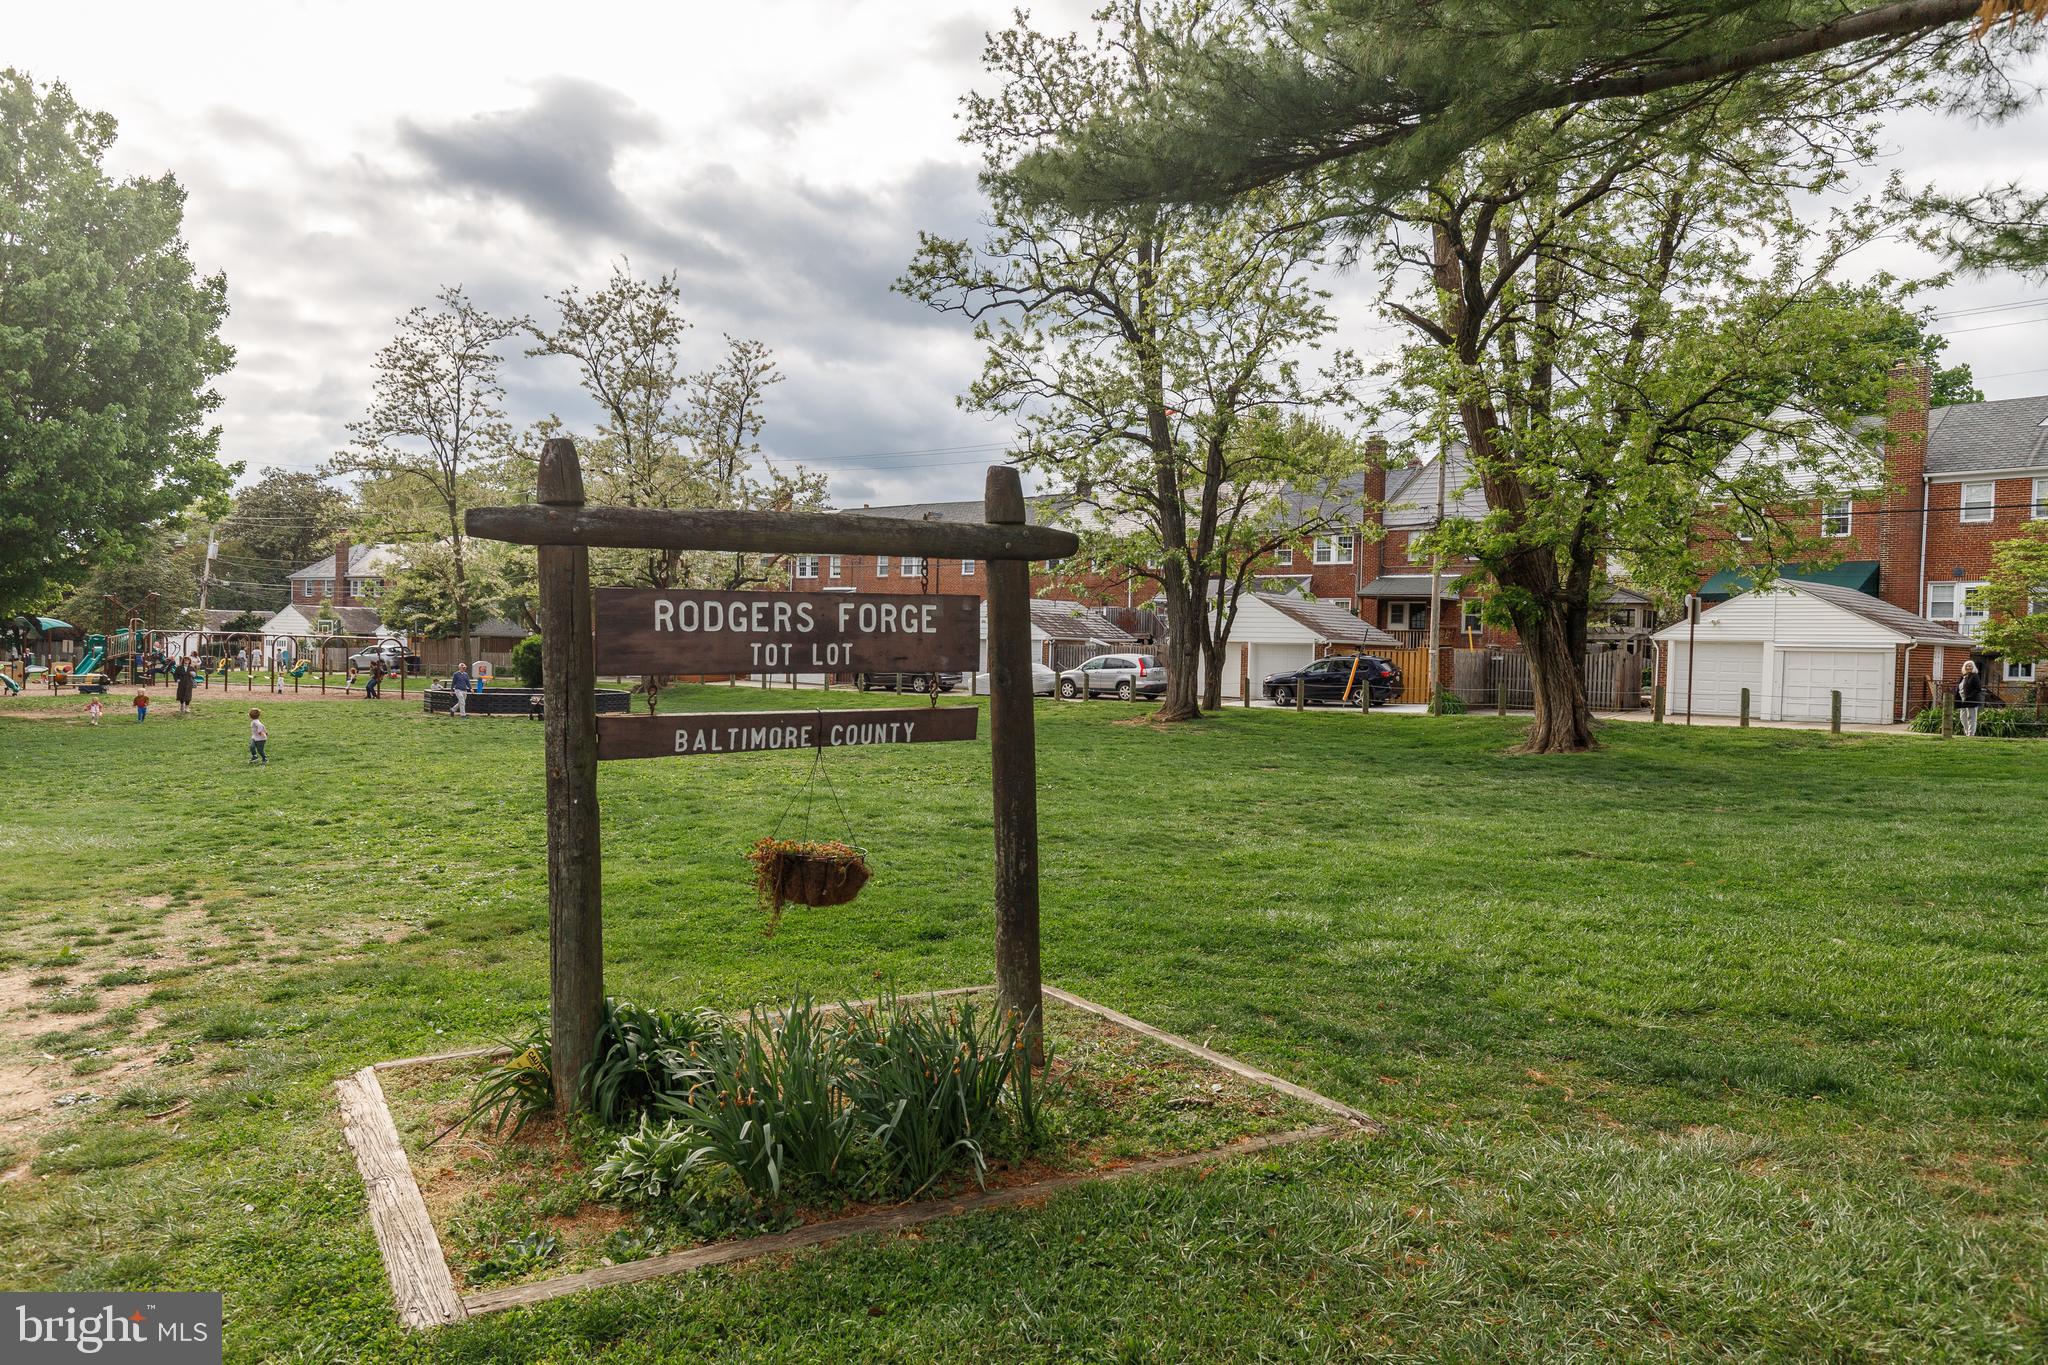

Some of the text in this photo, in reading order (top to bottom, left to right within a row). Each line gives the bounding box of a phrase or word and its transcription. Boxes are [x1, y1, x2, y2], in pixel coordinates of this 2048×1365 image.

[654, 599, 937, 634] RODGERS FORGE
[750, 642, 853, 666] TOT LOT
[674, 721, 915, 753] BALTIMORE COUNTY
